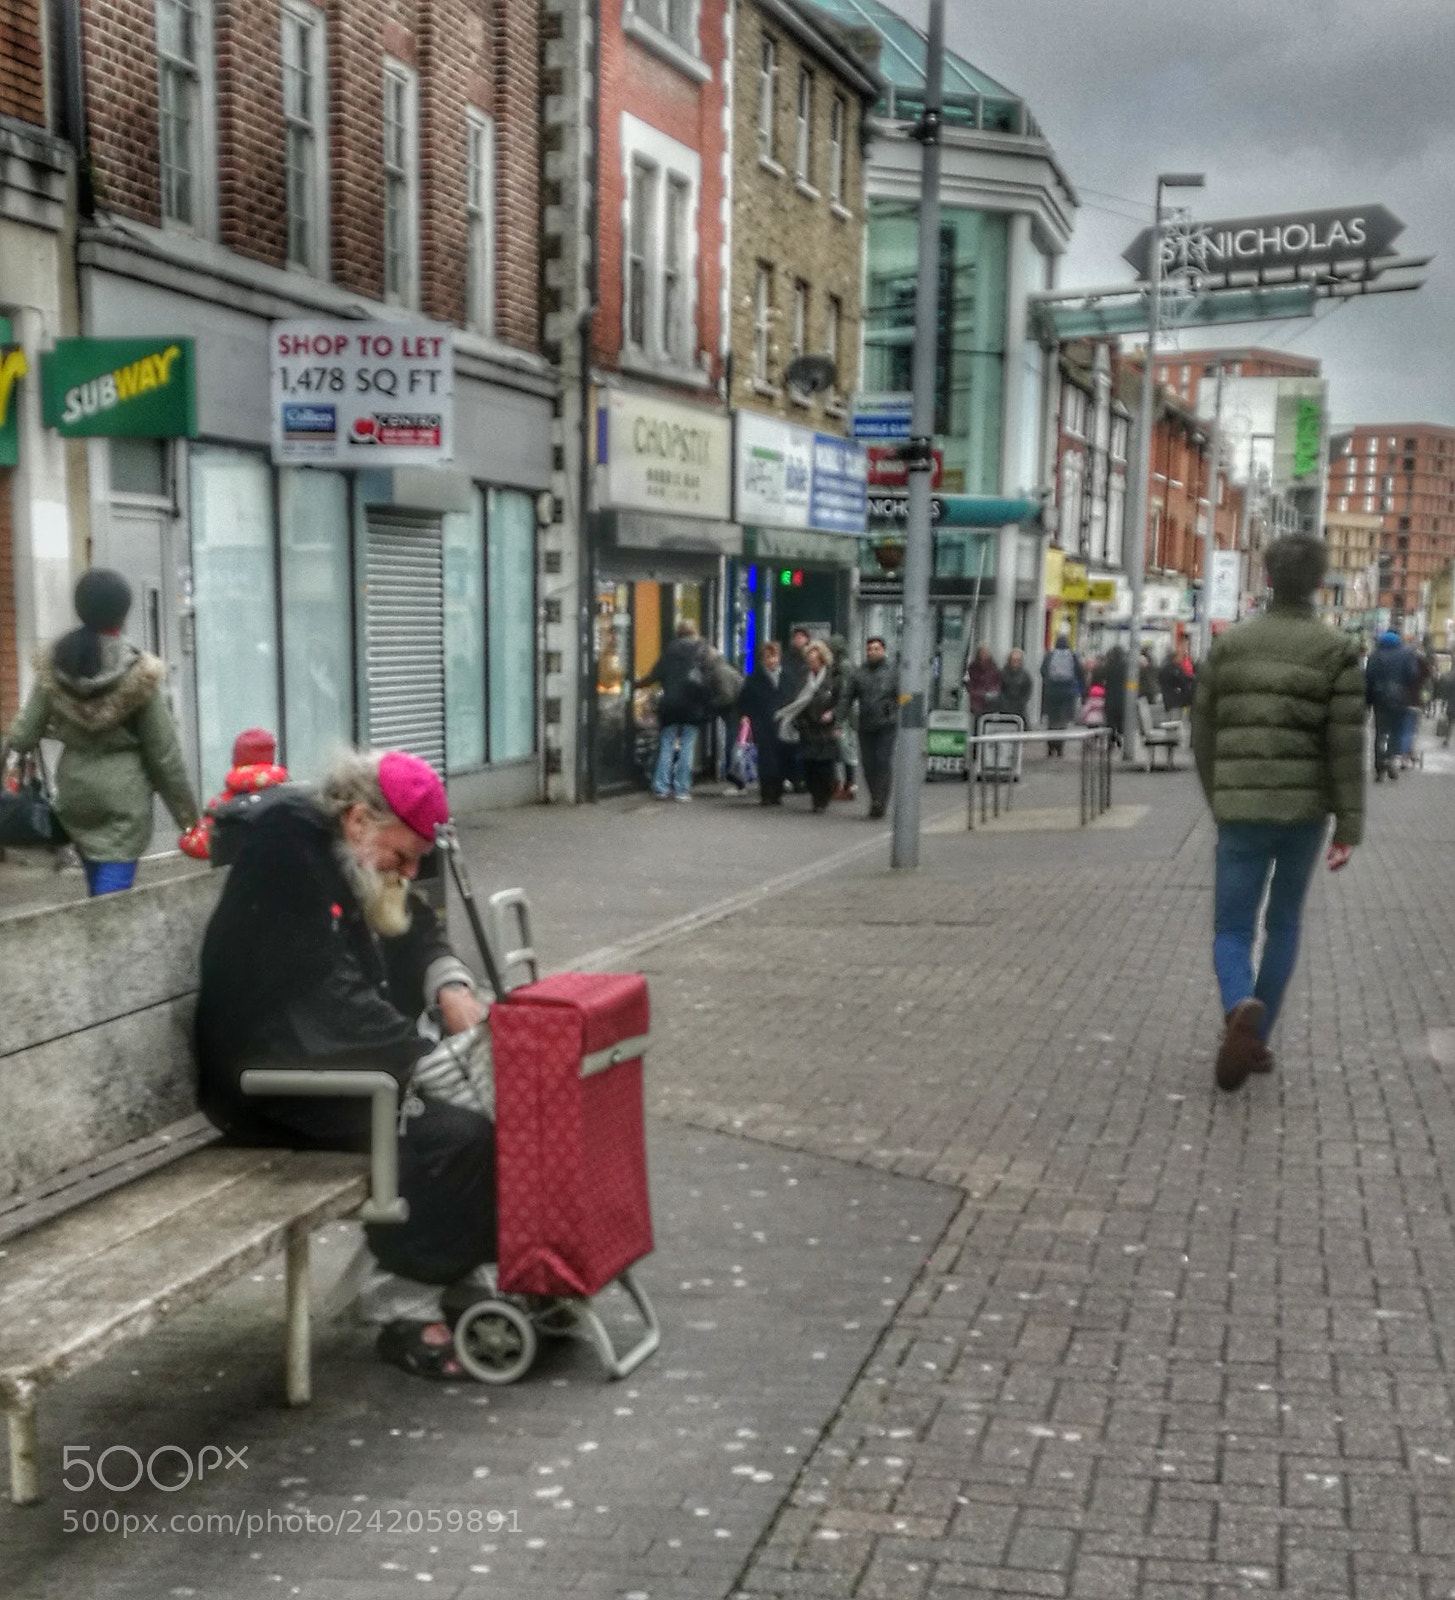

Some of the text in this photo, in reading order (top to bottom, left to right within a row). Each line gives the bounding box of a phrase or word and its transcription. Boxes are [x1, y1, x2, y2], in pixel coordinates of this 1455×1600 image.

[1202, 218, 1366, 259] NICHOLAS
[278, 333, 444, 357] SHOP TO LET
[61, 344, 180, 424] SUBWAY
[279, 366, 442, 397] 1,478 SQ FT
